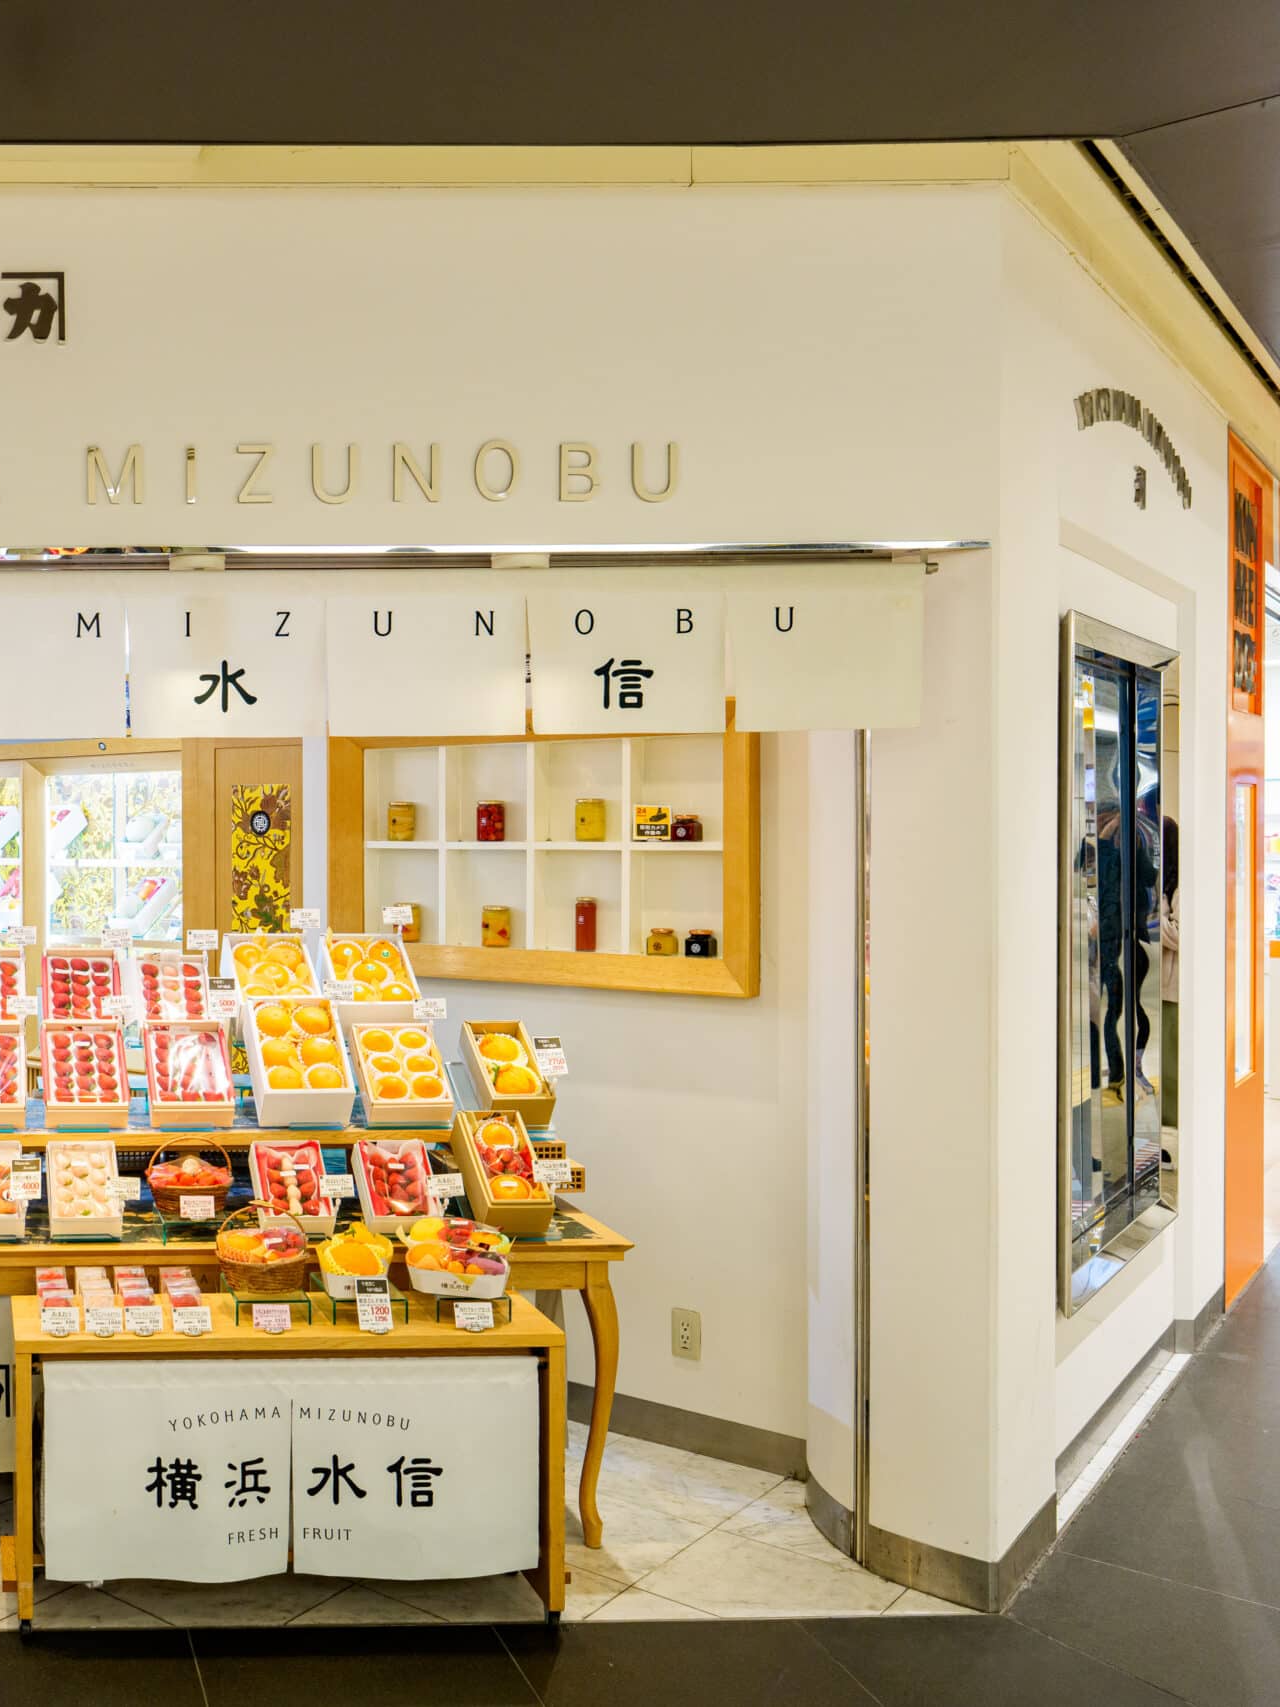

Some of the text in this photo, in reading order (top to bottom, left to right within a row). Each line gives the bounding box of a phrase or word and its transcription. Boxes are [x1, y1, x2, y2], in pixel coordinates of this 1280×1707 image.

[86, 440, 680, 505] MIZUNOBU
[371, 1306, 389, 1316] 1200
[168, 1407, 411, 1432] YOKOHAMA MIZUNOBU
[145, 1455, 444, 1511] 横浜水信
[228, 1527, 352, 1544] FRESH FRUIT
